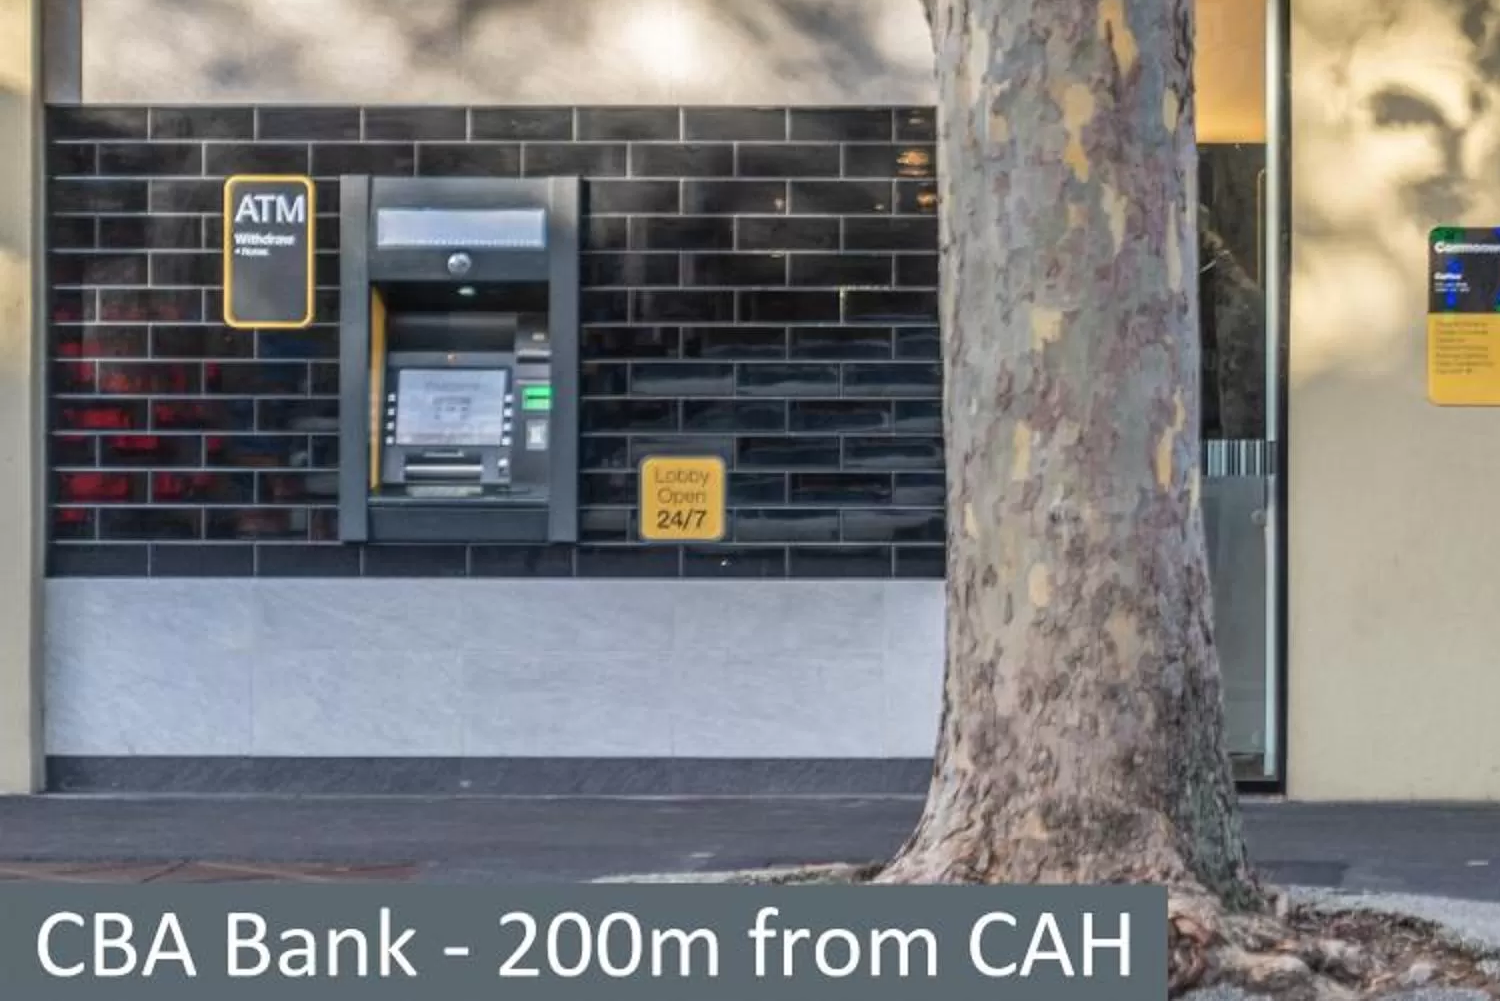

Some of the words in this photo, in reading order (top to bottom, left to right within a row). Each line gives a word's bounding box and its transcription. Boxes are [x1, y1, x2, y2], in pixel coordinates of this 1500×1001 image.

[234, 193, 305, 224] ATM
[234, 232, 297, 247] Withdraw
[655, 468, 709, 488] Lobby
[657, 486, 706, 507] Open
[656, 510, 708, 530] 24/7
